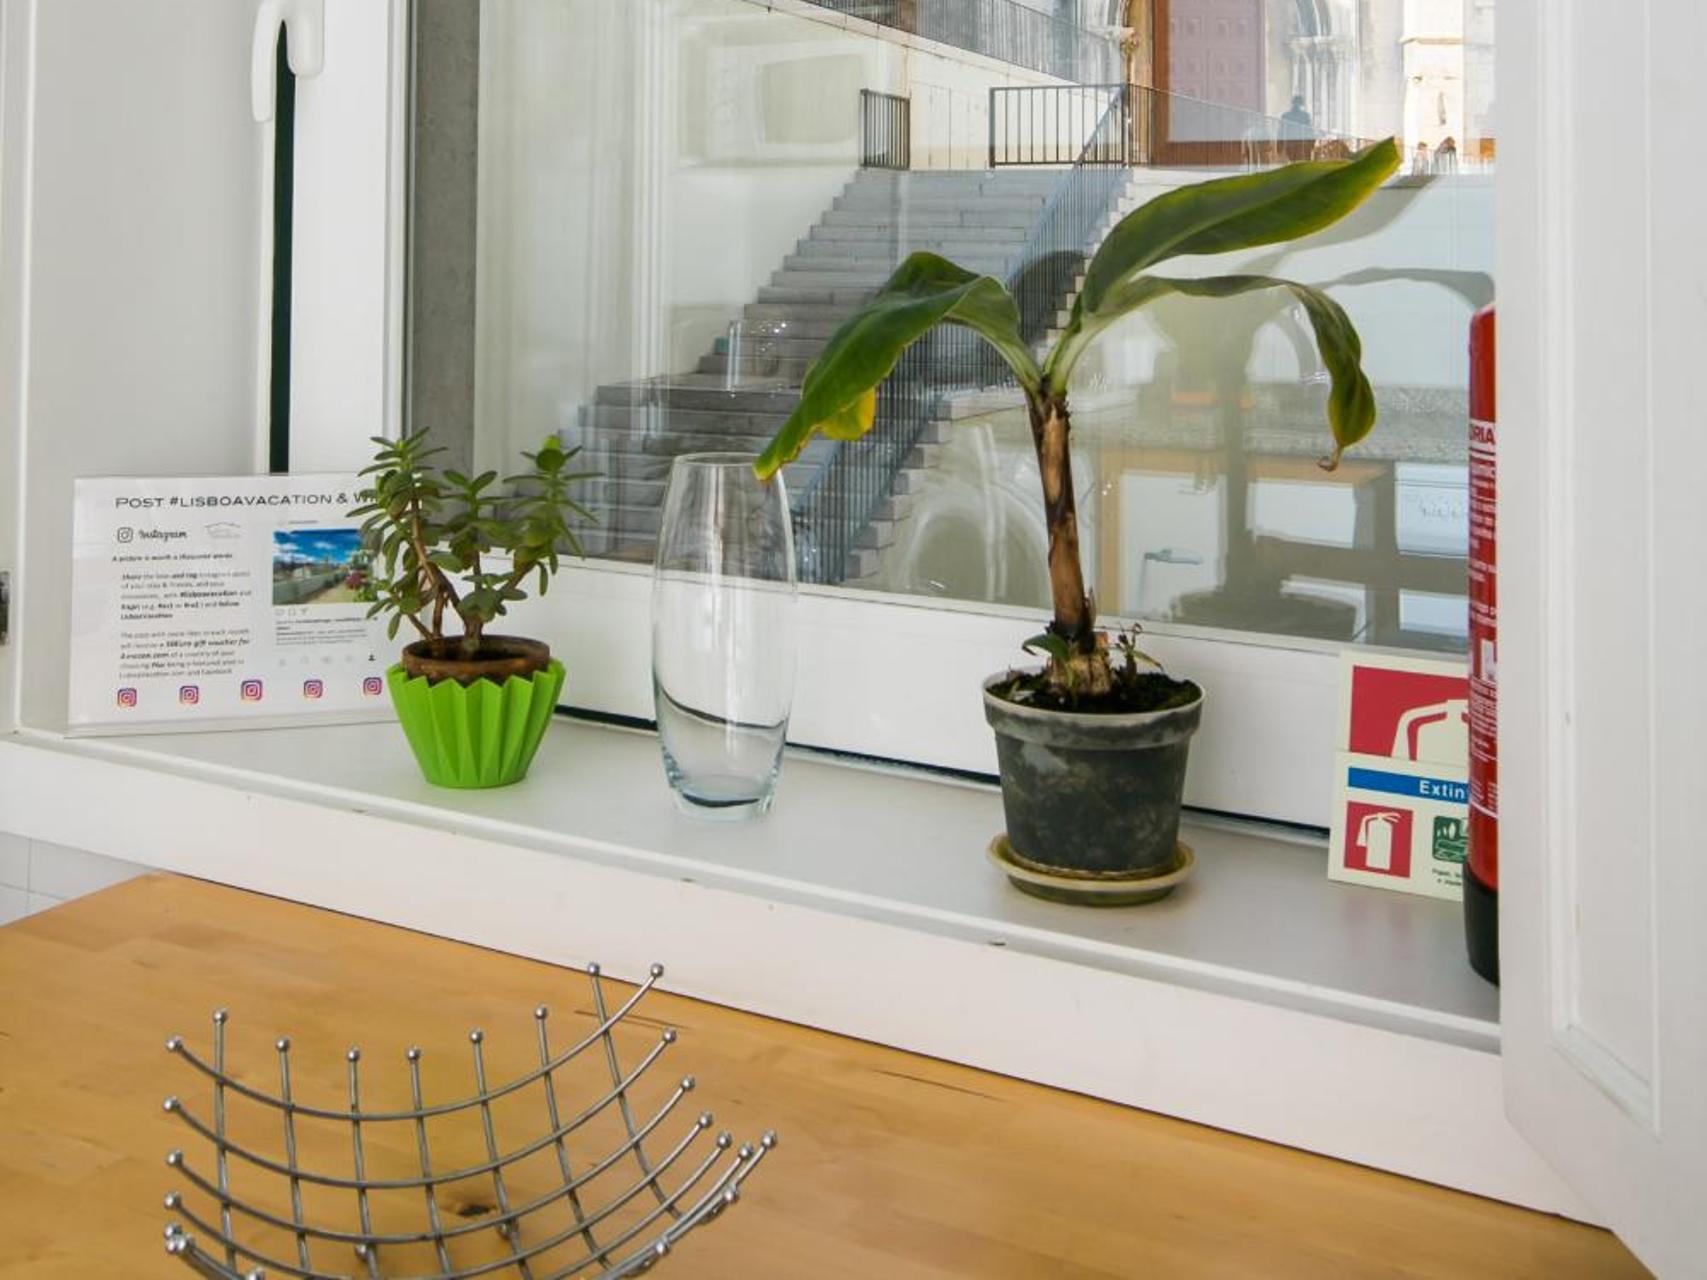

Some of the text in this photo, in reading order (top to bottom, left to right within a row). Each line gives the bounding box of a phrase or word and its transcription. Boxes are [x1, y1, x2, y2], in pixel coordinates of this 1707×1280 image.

[169, 493, 332, 508] #LISBOAVACATION
[336, 493, 348, 504] &
[138, 529, 188, 543] Instagram
[1419, 779, 1469, 800] Extin
